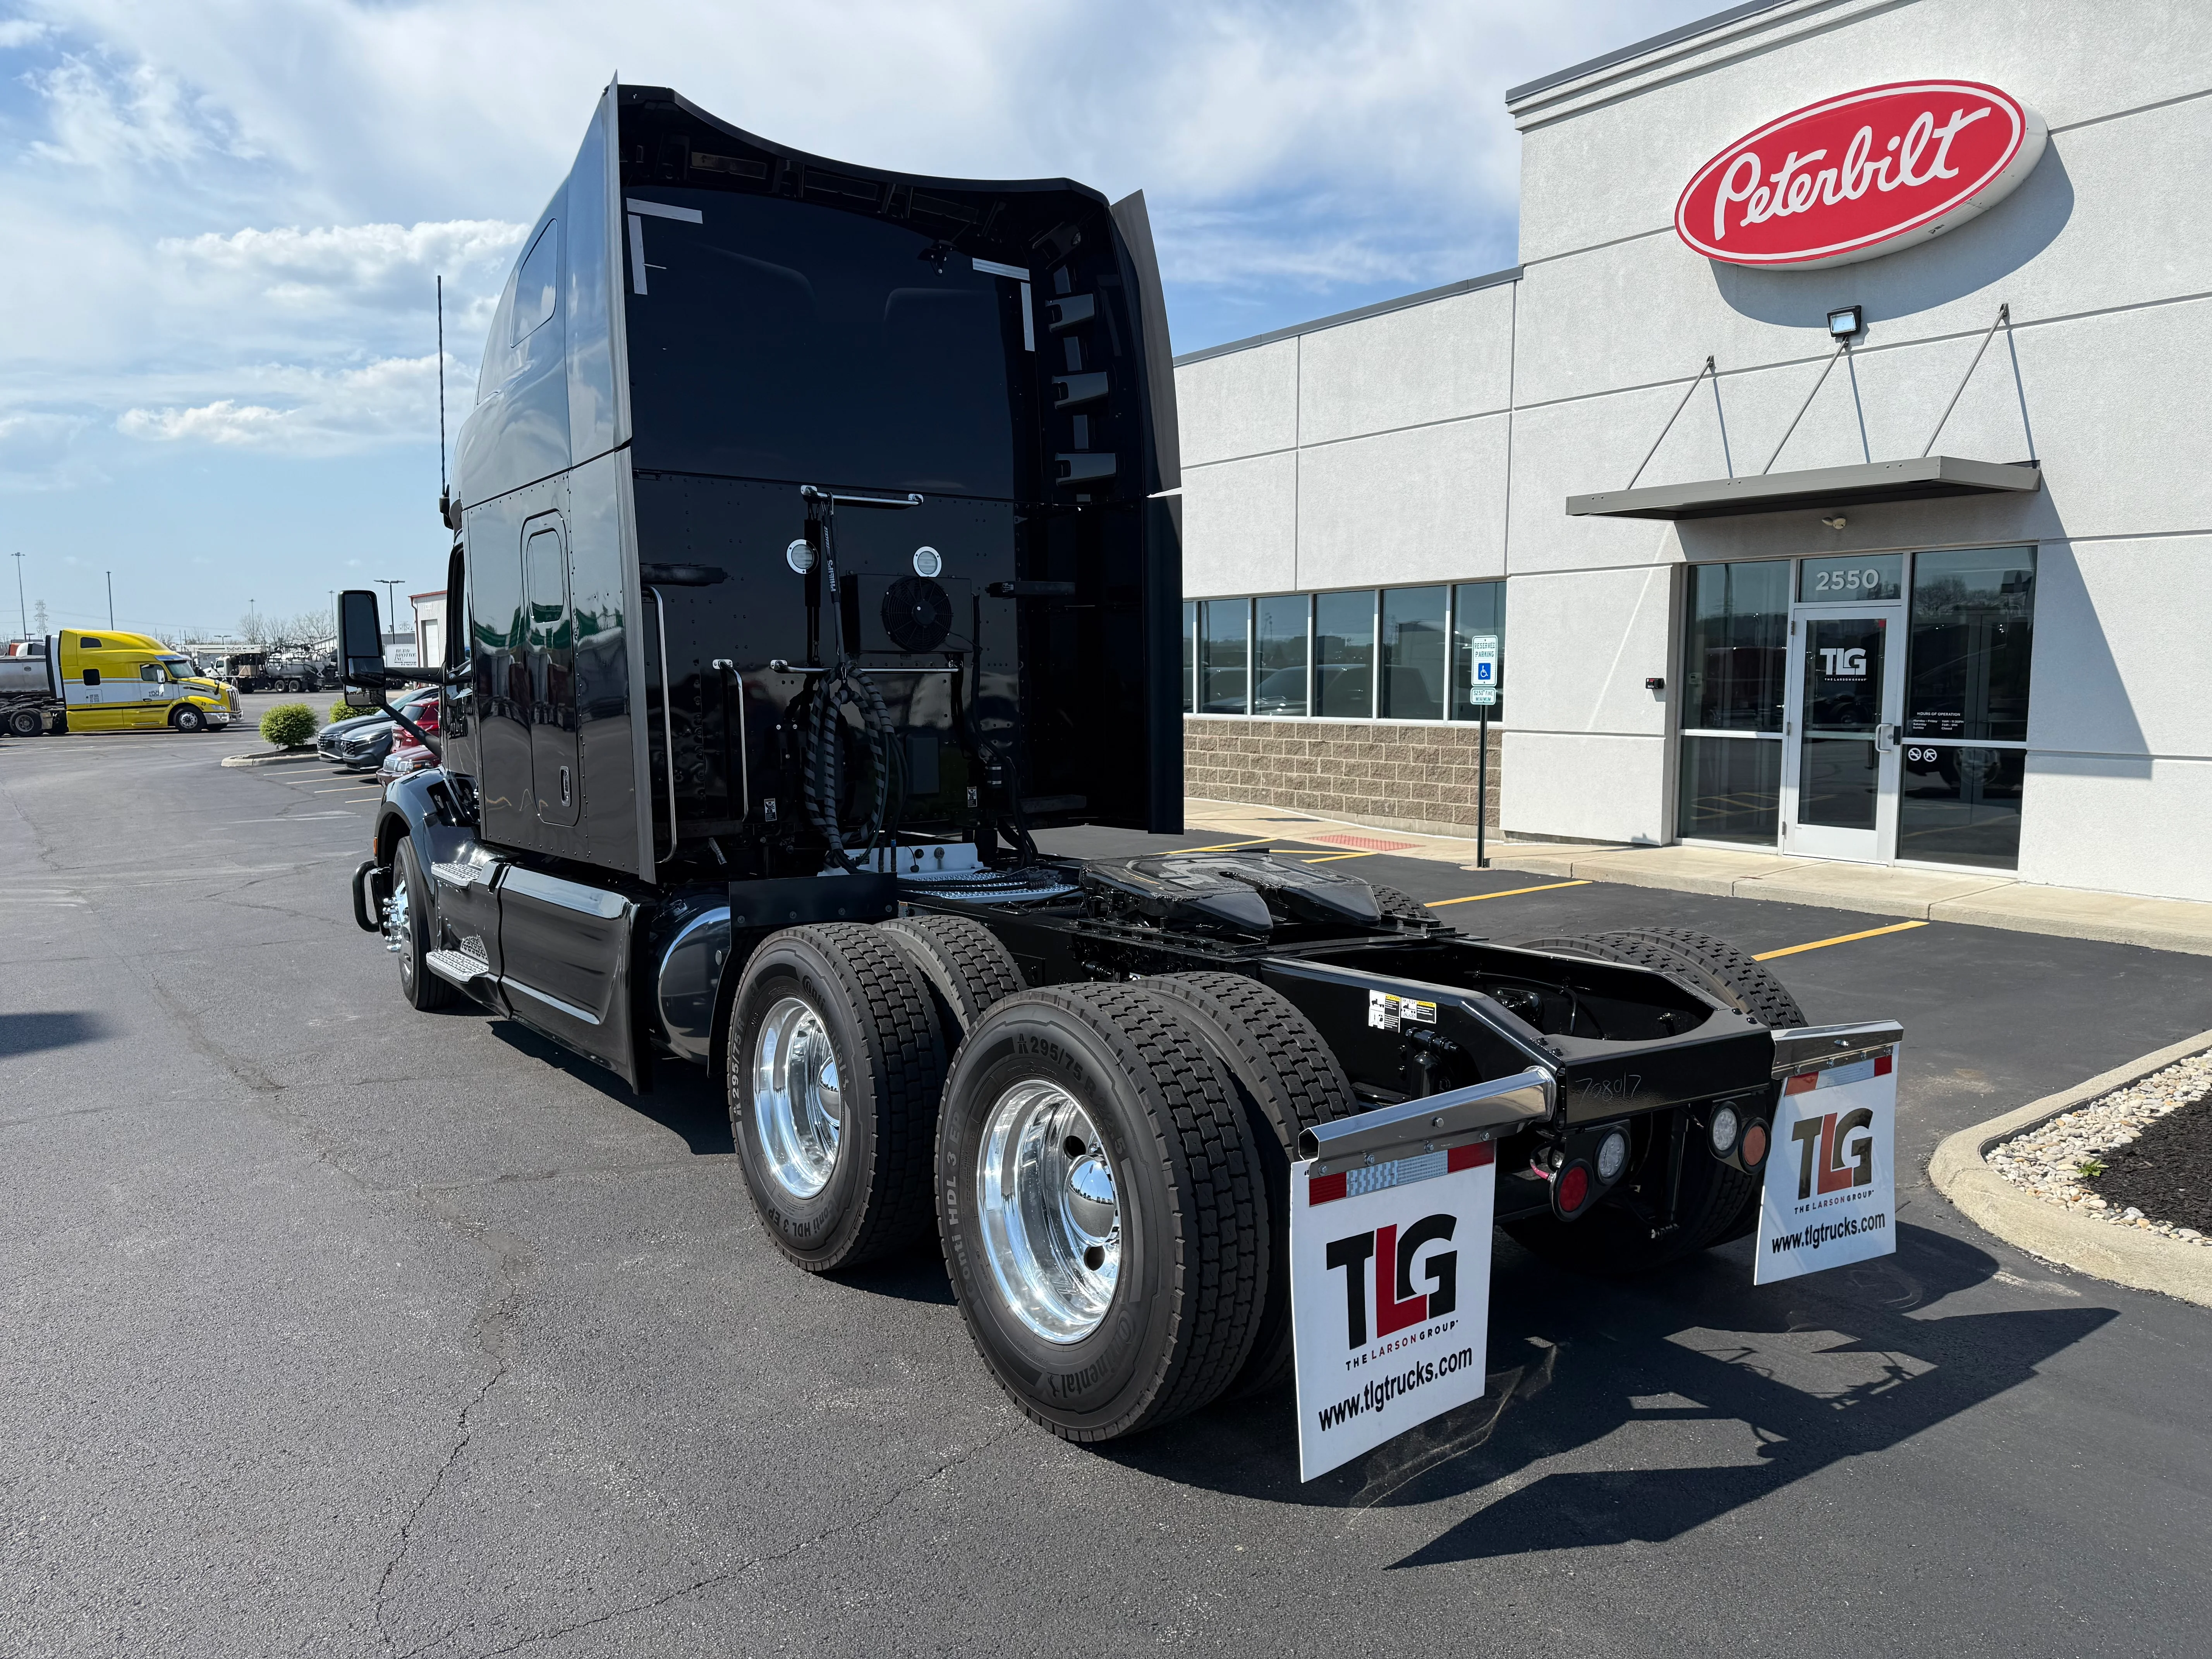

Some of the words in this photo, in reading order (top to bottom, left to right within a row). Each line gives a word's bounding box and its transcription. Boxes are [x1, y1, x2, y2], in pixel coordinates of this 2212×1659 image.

[1714, 107, 1991, 240] Peterbilt
[827, 560, 836, 592] PHILLIPS
[1815, 569, 1879, 591] 2550
[1820, 648, 1866, 675] TLG
[732, 1032, 741, 1099] 295/75
[737, 1017, 745, 1032] R
[1030, 1036, 1083, 1081] 295/75
[1084, 1075, 1097, 1100] R
[1094, 1097, 1126, 1154] 22.5
[1575, 1072, 1641, 1106] 708017
[949, 1110, 962, 1144] EP
[947, 1151, 957, 1166] 3
[1791, 1108, 1873, 1200] TLG
[768, 1207, 781, 1227] EP
[813, 1200, 833, 1234] Conti
[946, 1176, 959, 1225] HDL
[1795, 1204, 1810, 1214] THE
[1812, 1197, 1845, 1211] LARSON
[1846, 1190, 1872, 1203] GROUP
[783, 1219, 789, 1233] 3
[792, 1221, 811, 1237] HDL
[1772, 1211, 1885, 1254] www.tlgtrucks.com
[952, 1234, 973, 1298] Conti
[1326, 1214, 1457, 1350] TLG
[1060, 1310, 1132, 1399] Continental
[1345, 1354, 1368, 1371] THE
[1372, 1334, 1417, 1360] LARSON
[1419, 1321, 1455, 1341] GROUP
[1318, 1347, 1472, 1432] www.tlgtrucks.com
